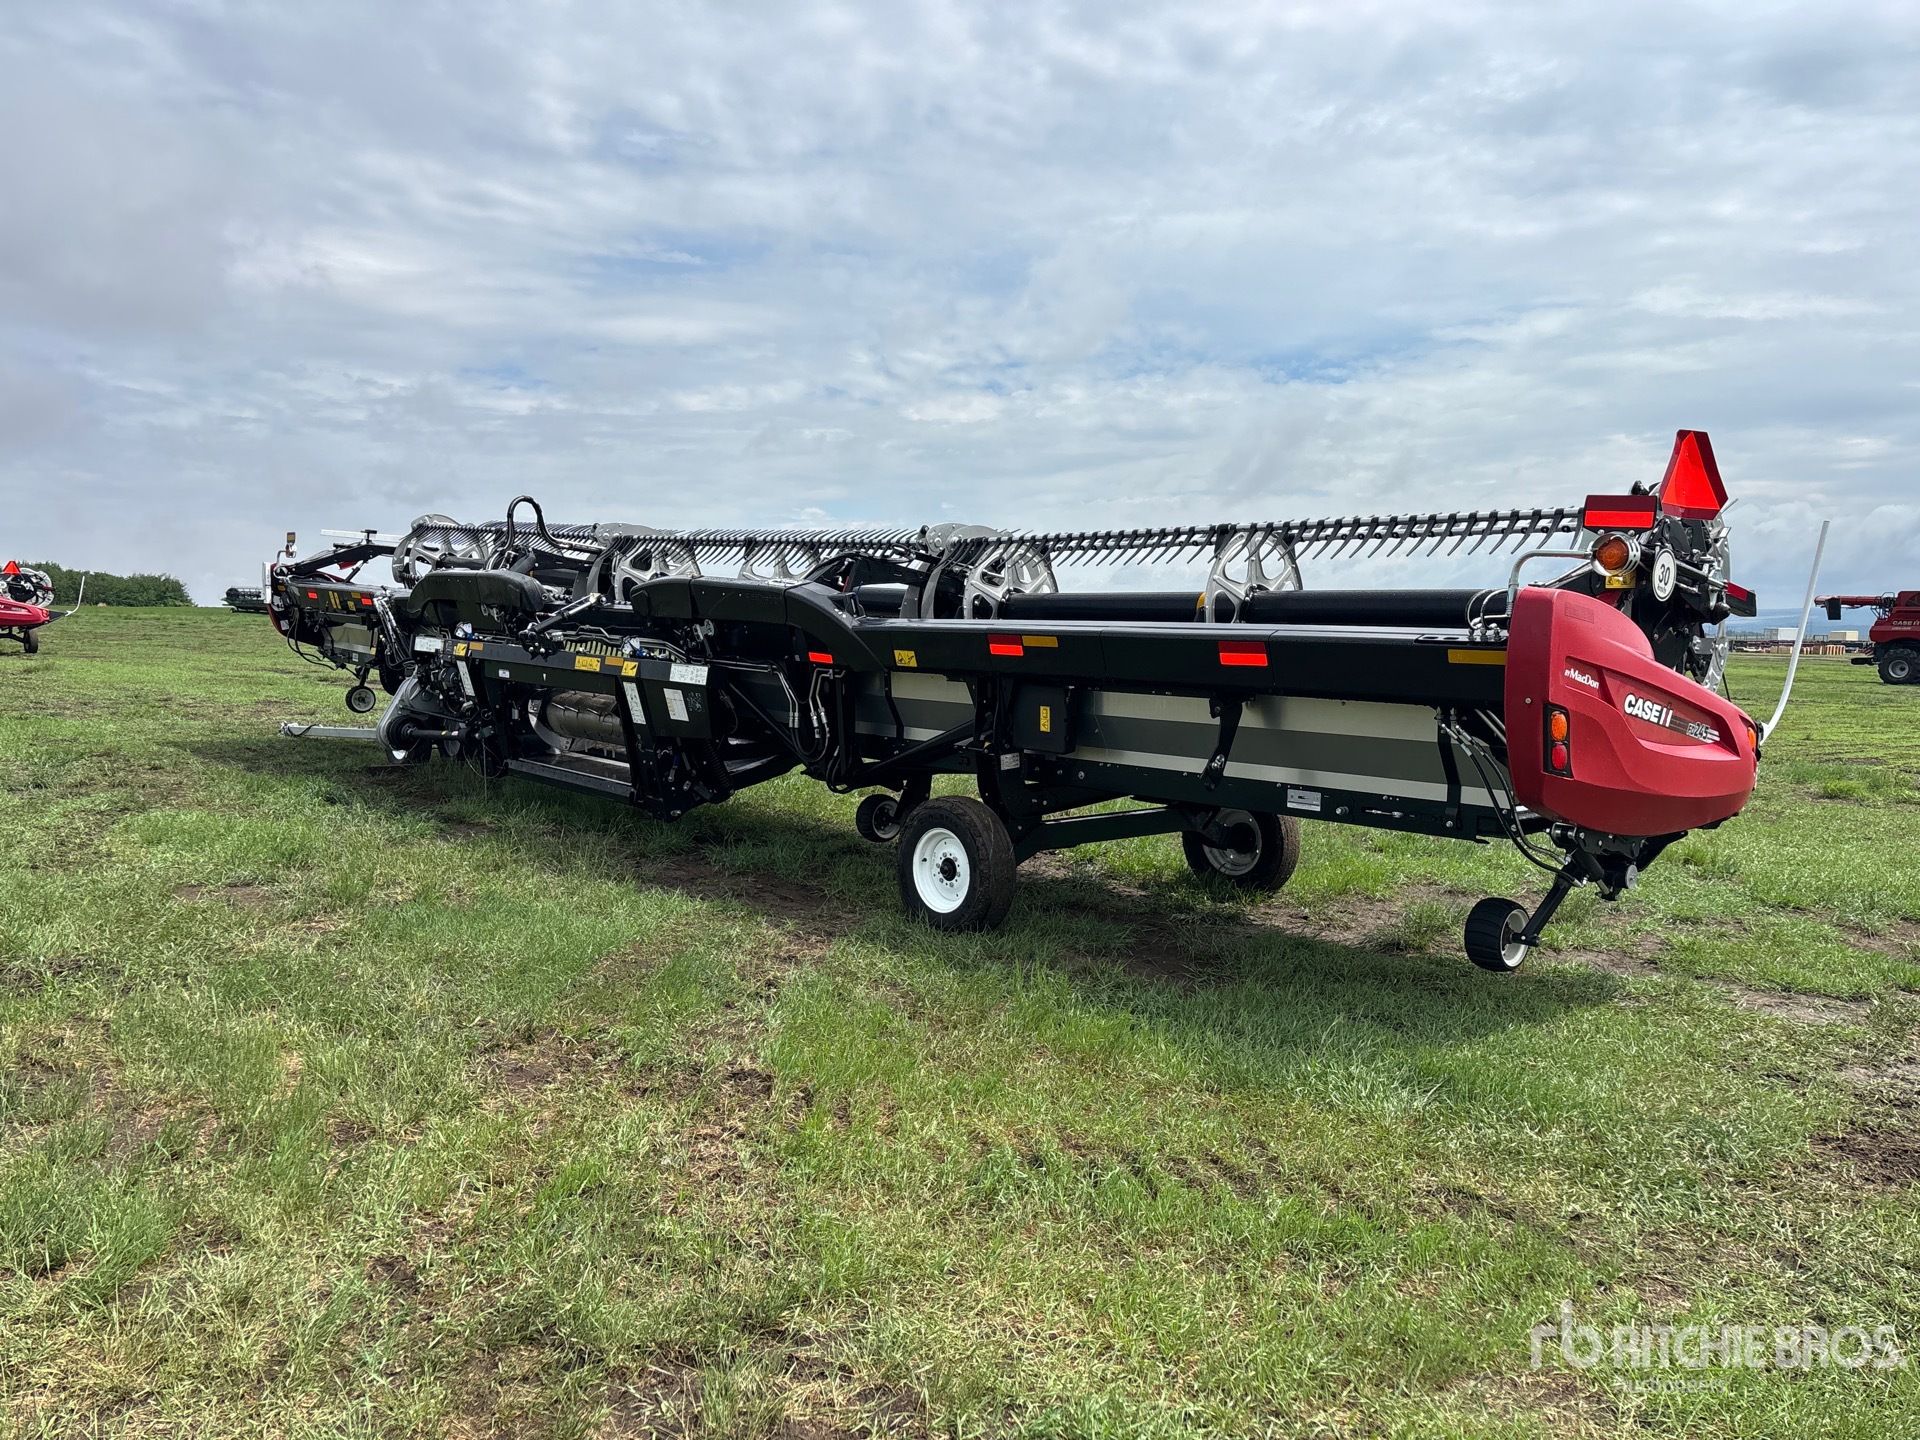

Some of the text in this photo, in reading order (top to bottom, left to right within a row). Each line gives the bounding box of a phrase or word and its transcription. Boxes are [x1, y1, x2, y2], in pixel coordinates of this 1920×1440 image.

[1658, 563, 1671, 587] 30
[1570, 667, 1599, 689] MacDon
[1624, 694, 1662, 723] CASE
